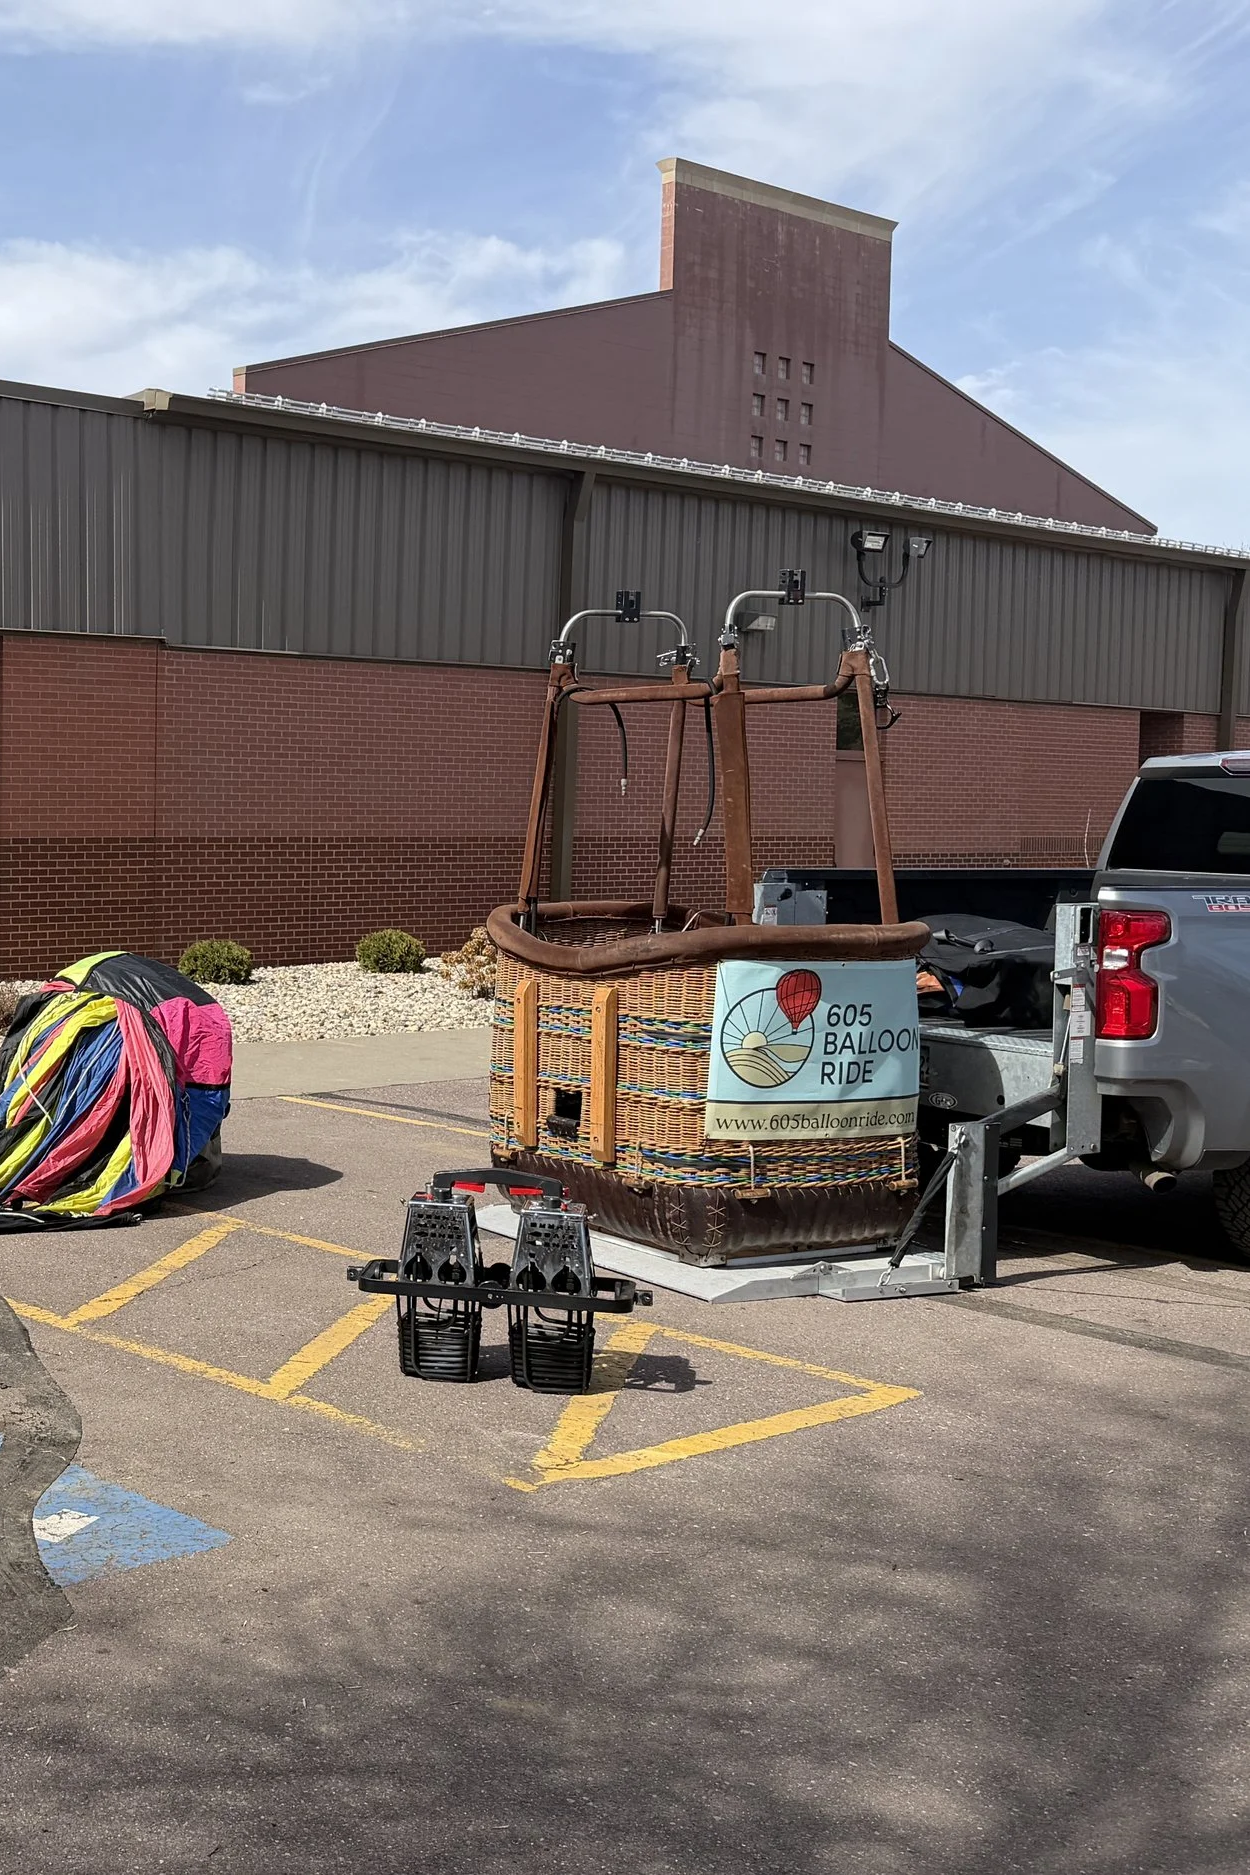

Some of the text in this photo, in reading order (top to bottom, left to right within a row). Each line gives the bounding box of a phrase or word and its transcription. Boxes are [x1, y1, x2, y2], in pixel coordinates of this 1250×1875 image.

[827, 1003, 872, 1027] 605
[823, 1028, 919, 1056] BALLOON
[820, 1060, 874, 1086] RIDE
[715, 1110, 915, 1131] www.605balloonride.com
